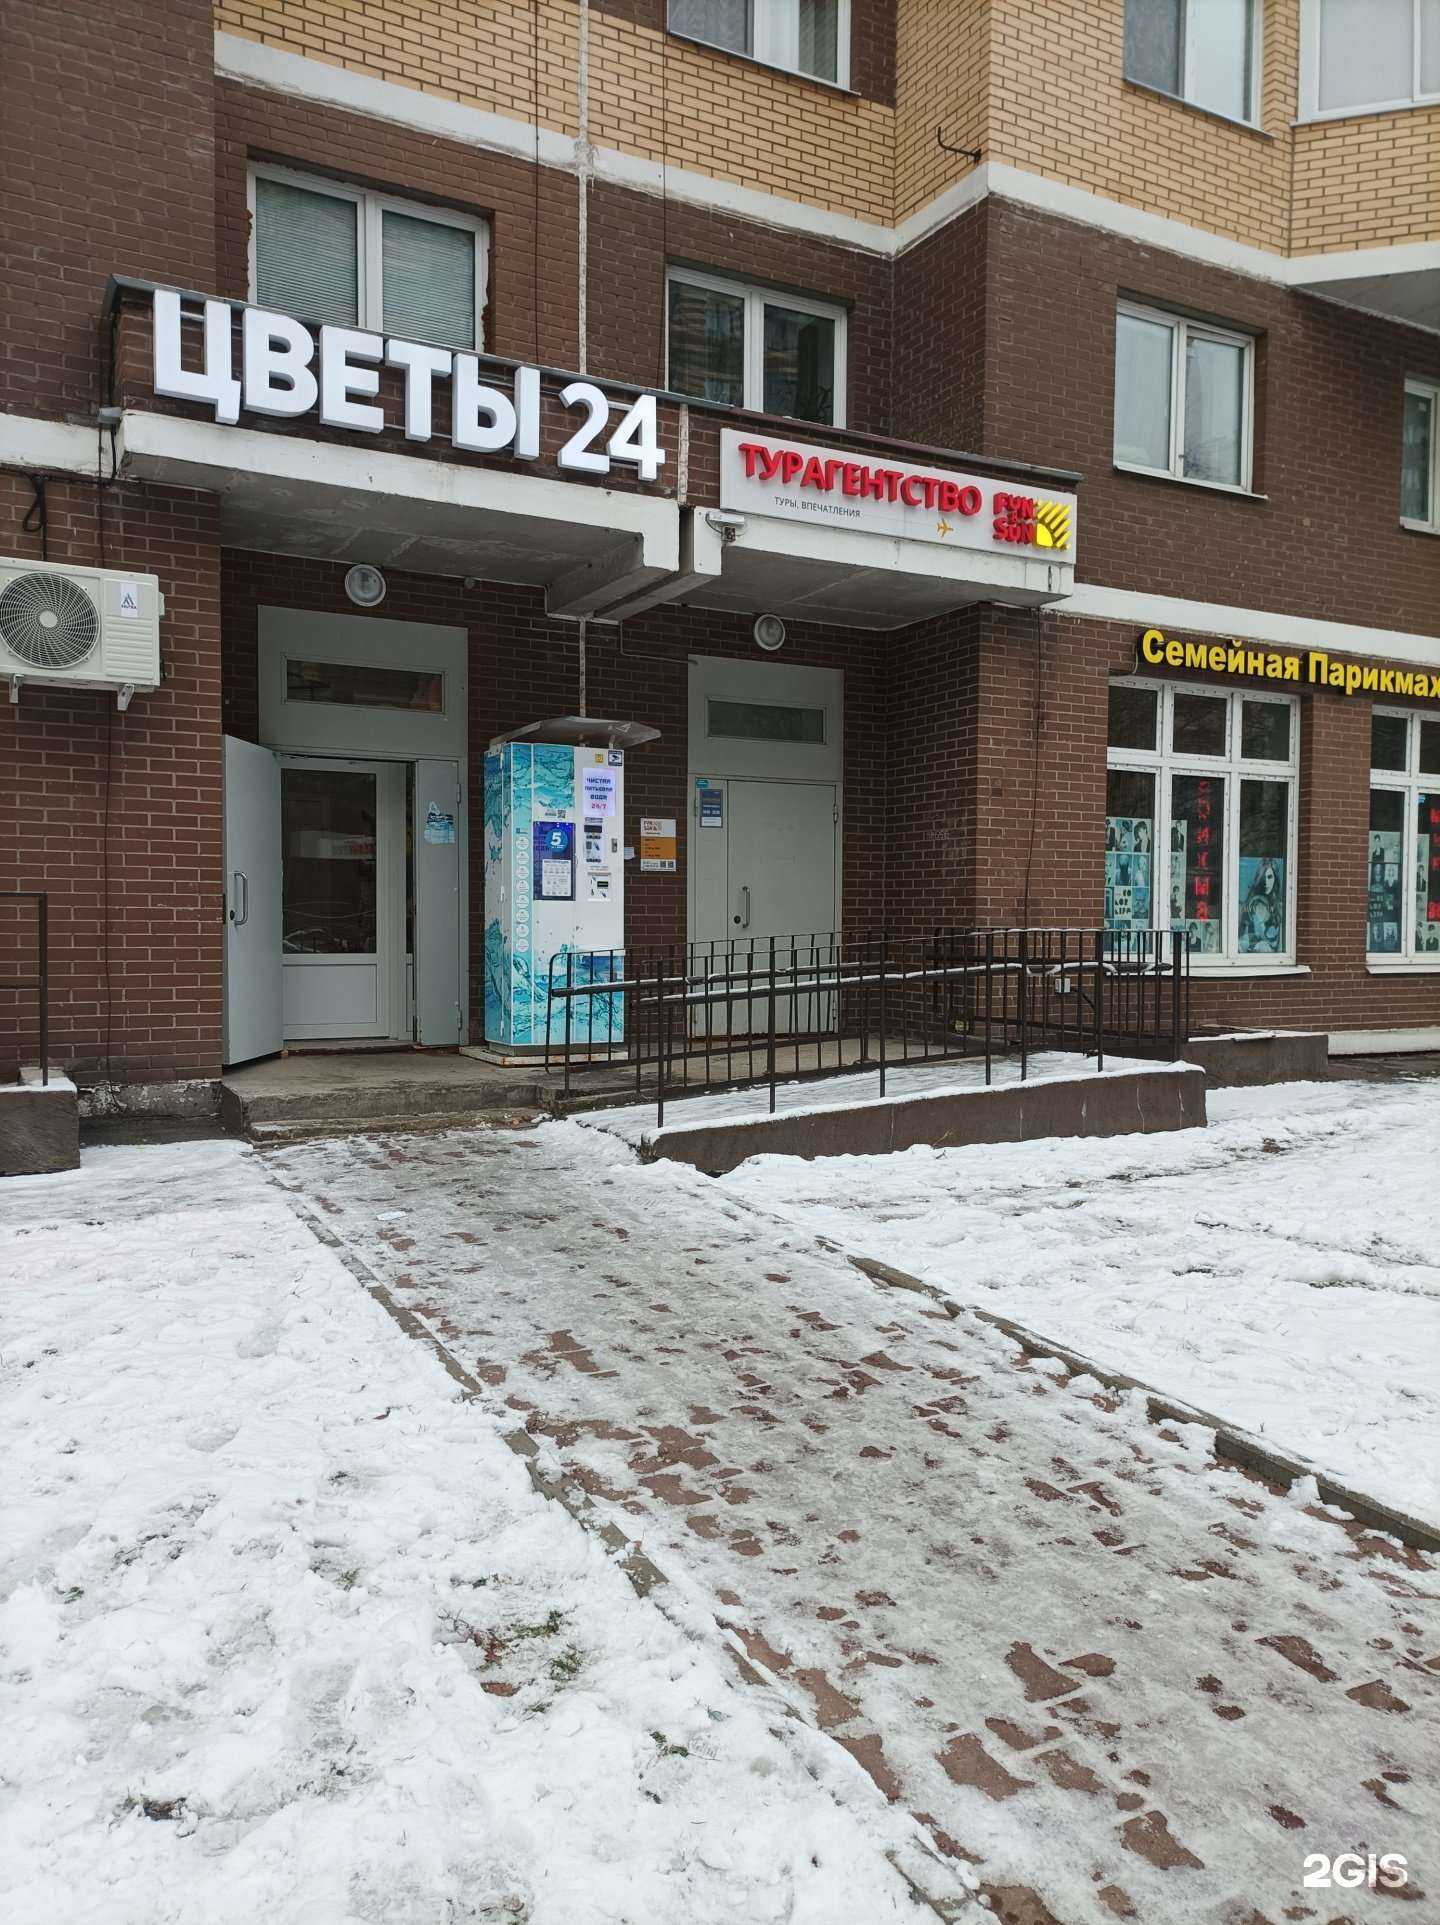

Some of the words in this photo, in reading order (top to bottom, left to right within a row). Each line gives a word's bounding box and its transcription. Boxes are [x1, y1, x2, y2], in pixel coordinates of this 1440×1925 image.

[153, 288, 541, 460] ЦВЕТЫ
[557, 381, 666, 482] 24
[738, 442, 983, 517] ТУРАГЕНТСТВО
[774, 496, 800, 510] ТУРЫ,
[801, 501, 862, 519] ВПЕЧАТЛЕНИЯ
[992, 517, 1035, 544] SUN
[1142, 629, 1300, 681] Семейная
[550, 831, 562, 846] 5
